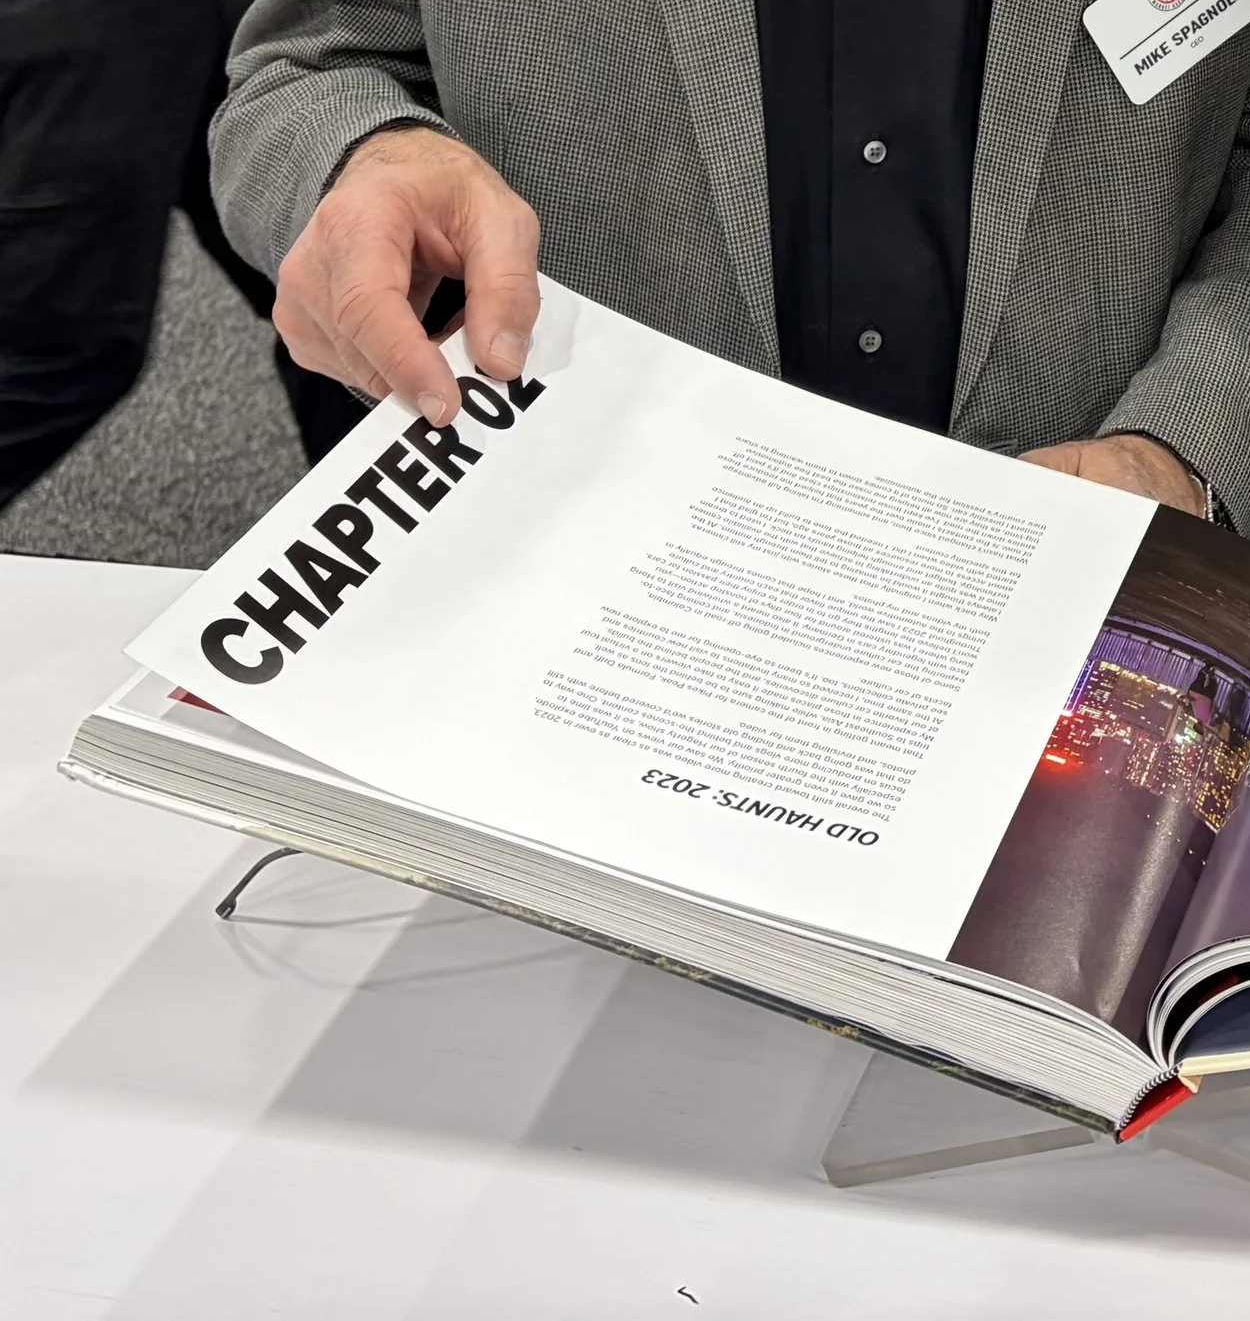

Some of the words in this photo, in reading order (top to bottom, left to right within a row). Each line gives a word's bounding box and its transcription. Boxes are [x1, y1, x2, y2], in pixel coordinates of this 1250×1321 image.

[1190, 36, 1204, 49] CEO
[1134, 41, 1172, 76] MIKE
[200, 415, 484, 685] CHAPTER
[580, 629, 601, 640] tour
[600, 636, 631, 651] virtual
[572, 647, 594, 658] and
[616, 652, 629, 660] as
[640, 650, 654, 659] on
[593, 654, 616, 667] Drift
[630, 656, 651, 669] lens
[655, 654, 692, 670] viewers
[546, 669, 565, 680] still
[617, 662, 657, 681] Formula
[651, 664, 669, 674] the
[693, 667, 715, 678] take
[566, 676, 587, 688] with
[668, 669, 704, 685] behind
[716, 674, 727, 682] to
[727, 676, 752, 689] easy
[542, 679, 554, 688] to
[554, 682, 575, 694] way
[704, 680, 719, 690] be
[719, 685, 731, 693] to
[751, 685, 760, 693] it
[576, 690, 598, 703] One
[588, 684, 622, 700] before
[686, 684, 713, 698] Pikes
[731, 689, 754, 700] sure
[760, 688, 789, 701] made
[556, 694, 568, 703] to
[569, 698, 591, 711] time
[621, 695, 663, 712] covered
[713, 694, 729, 703] for
[754, 694, 791, 711] making
[789, 696, 823, 711] places
[592, 706, 612, 718] was
[729, 698, 766, 714] camera
[613, 713, 622, 722] it
[662, 708, 687, 720] we'd
[767, 710, 784, 720] the
[791, 707, 818, 719] while
[823, 706, 851, 719] those
[852, 714, 863, 723] in
[562, 718, 574, 727] in
[577, 712, 619, 732] YouTube
[622, 716, 636, 725] so
[688, 716, 722, 731] stories
[783, 715, 796, 723] of
[796, 718, 821, 731] front
[573, 722, 597, 734] ever
[621, 727, 636, 736] on
[721, 727, 739, 737] old
[822, 725, 832, 734] in
[844, 722, 895, 742] Southeast
[863, 717, 918, 737] experience
[598, 730, 611, 739] as
[637, 732, 665, 745] views
[666, 729, 708, 749] Hagerty
[740, 731, 775, 748] finding
[768, 731, 783, 741] for
[833, 727, 869, 743] getting
[895, 736, 907, 745] to
[918, 732, 935, 743] My
[611, 735, 637, 747] clear
[638, 743, 651, 751] as
[666, 741, 685, 751] our
[732, 740, 754, 751] and
[784, 735, 810, 748] them
[869, 739, 902, 753] meant
[908, 739, 931, 751] trips
[652, 747, 673, 758] was
[685, 747, 707, 758] saw
[709, 744, 727, 753] our
[726, 749, 739, 757] of
[754, 747, 781, 760] vlogs
[775, 743, 797, 753] and
[811, 742, 857, 760] revisiting
[902, 748, 924, 760] That
[674, 754, 703, 768] video
[707, 754, 725, 765] We
[739, 753, 777, 768] season
[783, 755, 810, 767] more
[797, 749, 822, 762] back
[856, 755, 878, 766] and
[823, 755, 853, 769] going
[703, 763, 731, 776] more
[777, 764, 809, 778] fourth
[810, 762, 863, 782] producing
[853, 765, 874, 775] was
[731, 770, 774, 789] creating
[765, 771, 803, 786] greater
[809, 773, 827, 783] the
[863, 777, 878, 786] on
[875, 770, 896, 782] that
[897, 776, 912, 785] do
[641, 769, 711, 799] 2023
[803, 782, 830, 793] even
[828, 778, 850, 789] with
[878, 782, 907, 795] focus
[773, 784, 810, 800] toward
[830, 789, 839, 797] it
[839, 791, 866, 803] gave
[850, 784, 902, 803] especially
[811, 794, 835, 806] shift
[866, 799, 882, 808] we
[711, 789, 825, 832] HAUNTS:
[834, 801, 870, 815] overall
[883, 804, 897, 812] so
[871, 811, 891, 822] The
[826, 823, 880, 846] OLD
